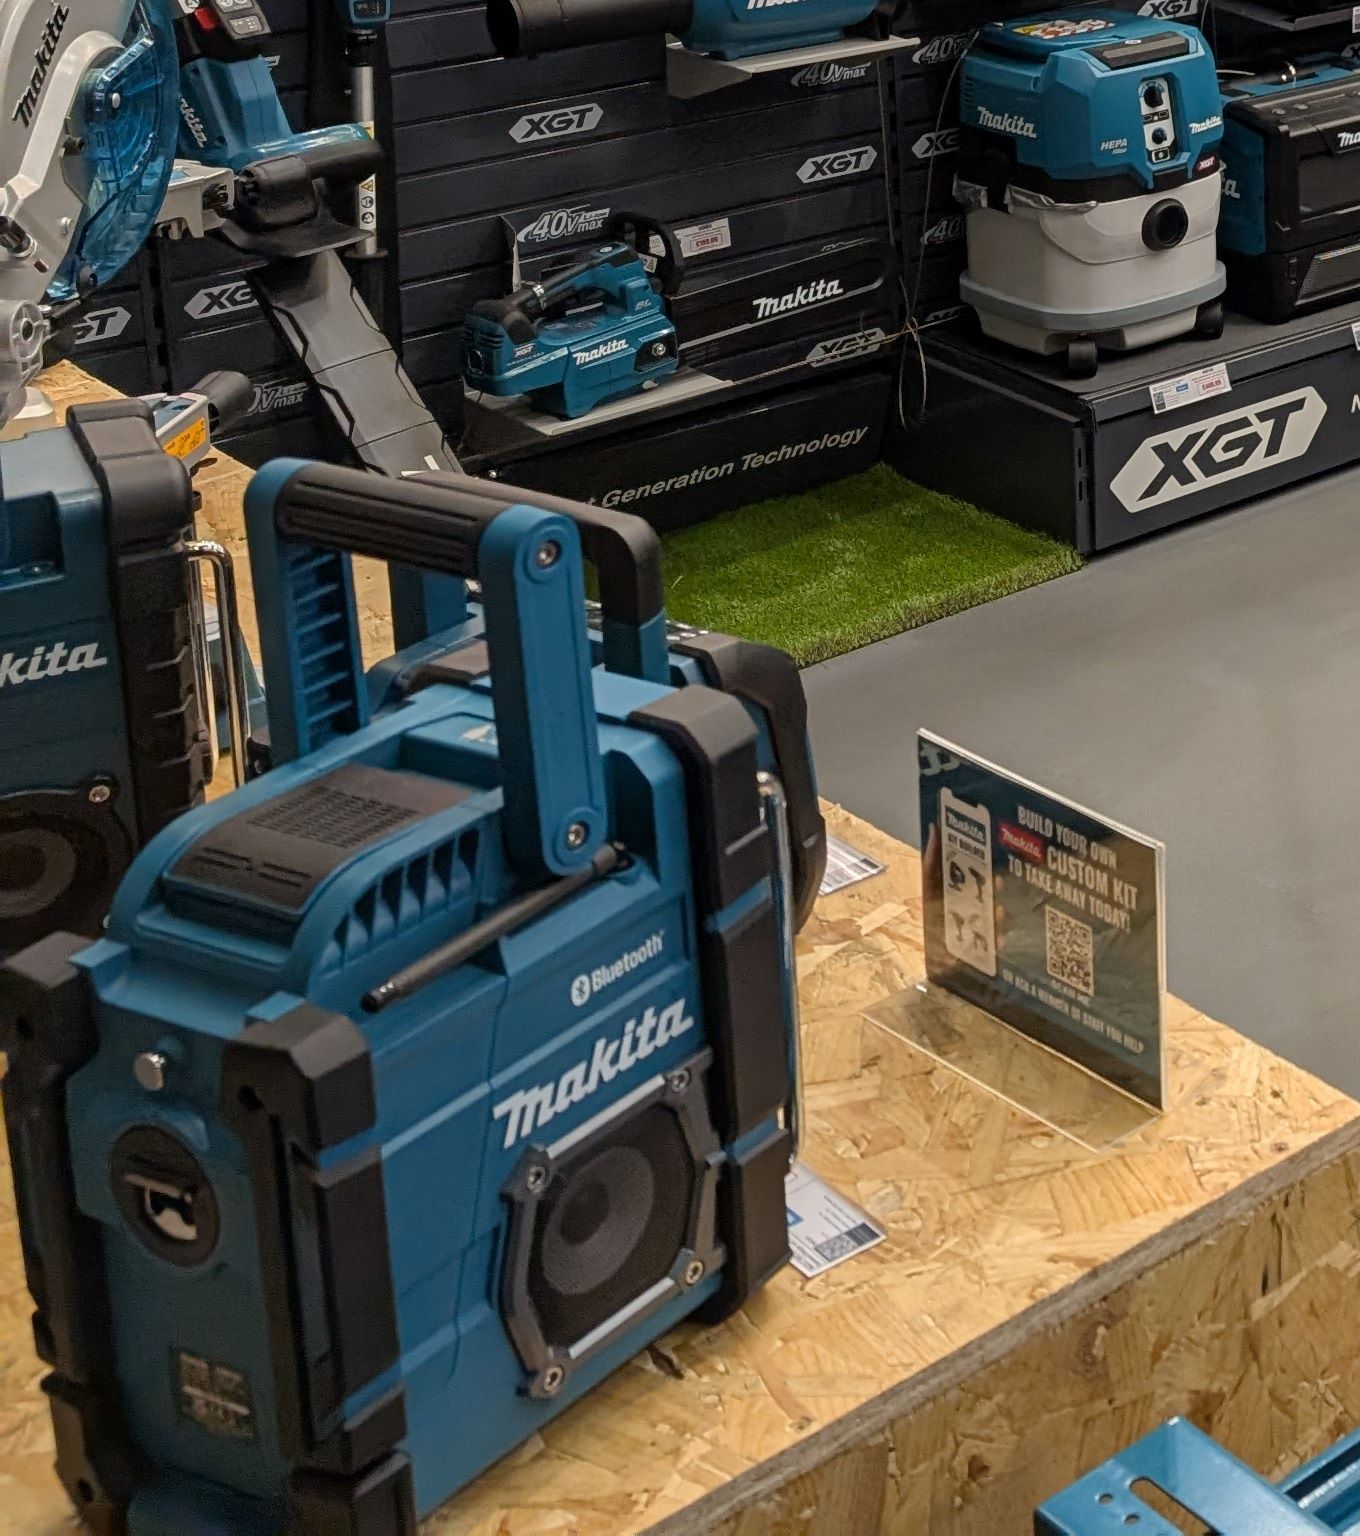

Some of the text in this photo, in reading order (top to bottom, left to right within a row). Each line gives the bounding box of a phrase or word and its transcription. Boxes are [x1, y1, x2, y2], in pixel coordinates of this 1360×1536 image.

[524, 110, 593, 139] XGT
[977, 105, 1037, 140] Makita
[1101, 138, 1128, 151] HEPA
[806, 150, 868, 179] XGT
[573, 338, 629, 366] Makita
[602, 425, 870, 507] Generation Technology
[1137, 395, 1310, 505] XGT
[1018, 804, 1118, 871] BUILD YOUR OWN
[1008, 853, 1132, 935] TO TAKE AWAY TODAY!
[1047, 846, 1110, 894] CUSTOM
[1113, 876, 1139, 911] KIT
[591, 930, 665, 993] Bluetooth
[494, 997, 694, 1148] Makita
